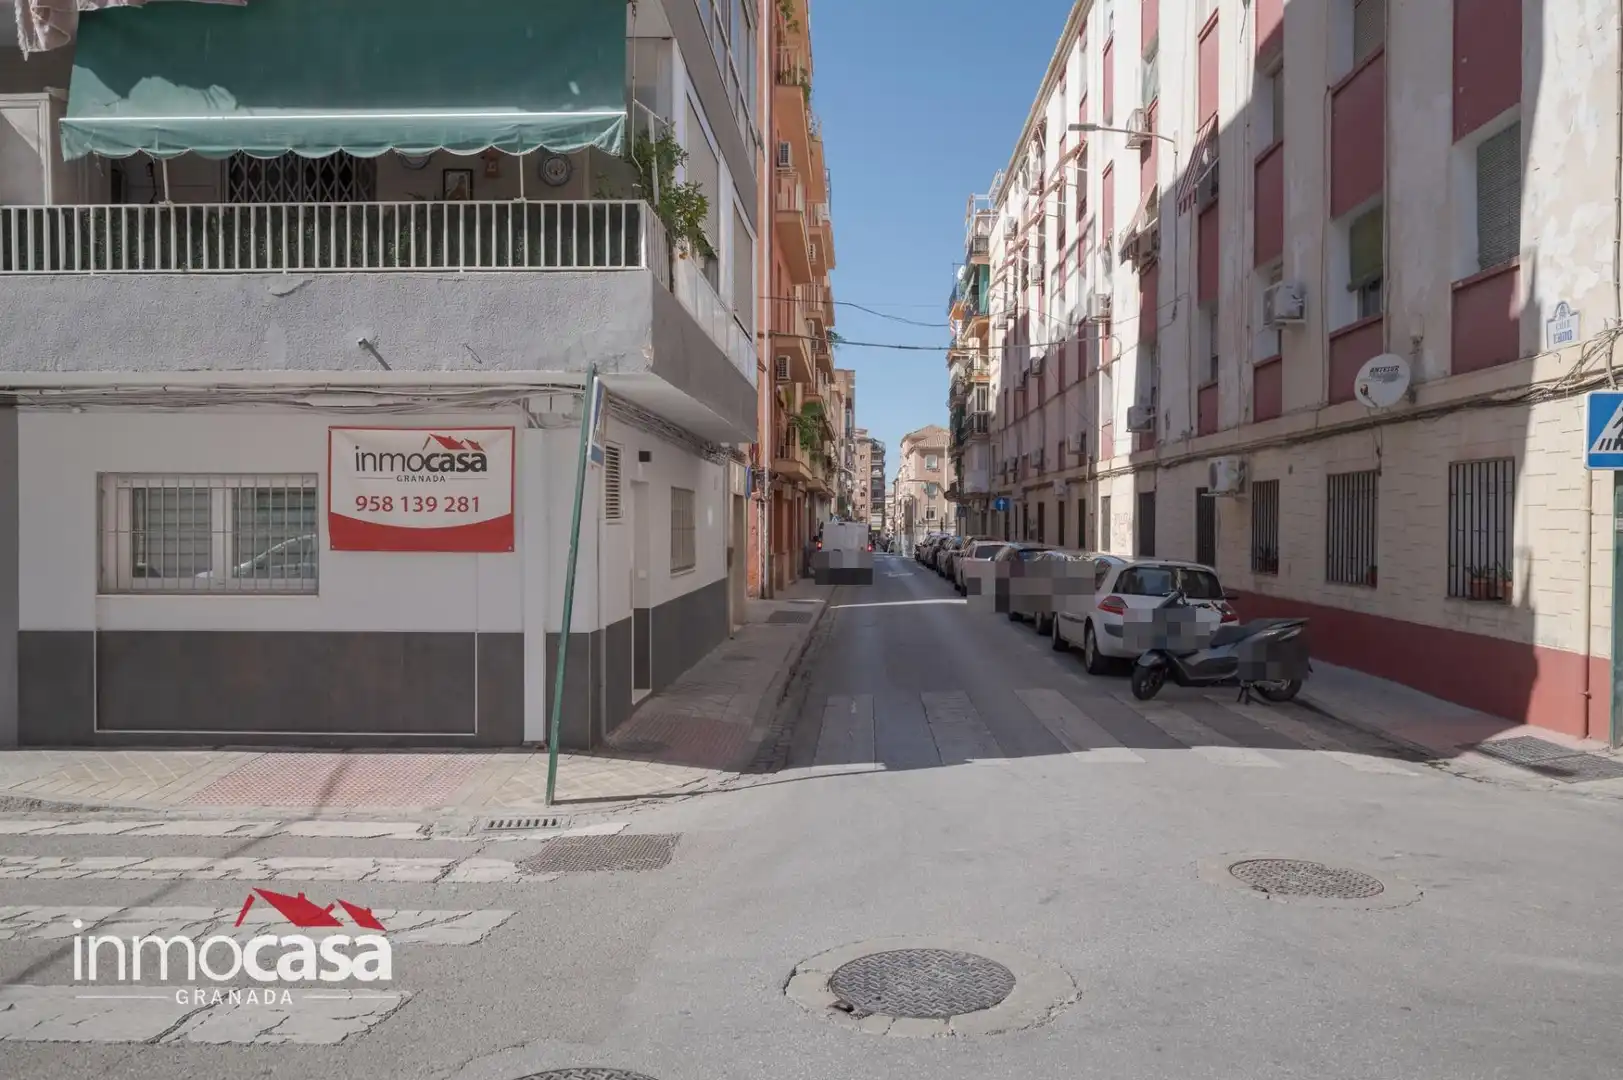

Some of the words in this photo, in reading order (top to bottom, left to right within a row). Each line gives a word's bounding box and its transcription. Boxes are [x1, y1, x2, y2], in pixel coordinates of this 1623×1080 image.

[355, 445, 487, 473] inmocasa
[396, 474, 446, 483] GRANADA
[355, 495, 393, 512] 958
[400, 495, 438, 512] 139
[443, 495, 479, 512] 281
